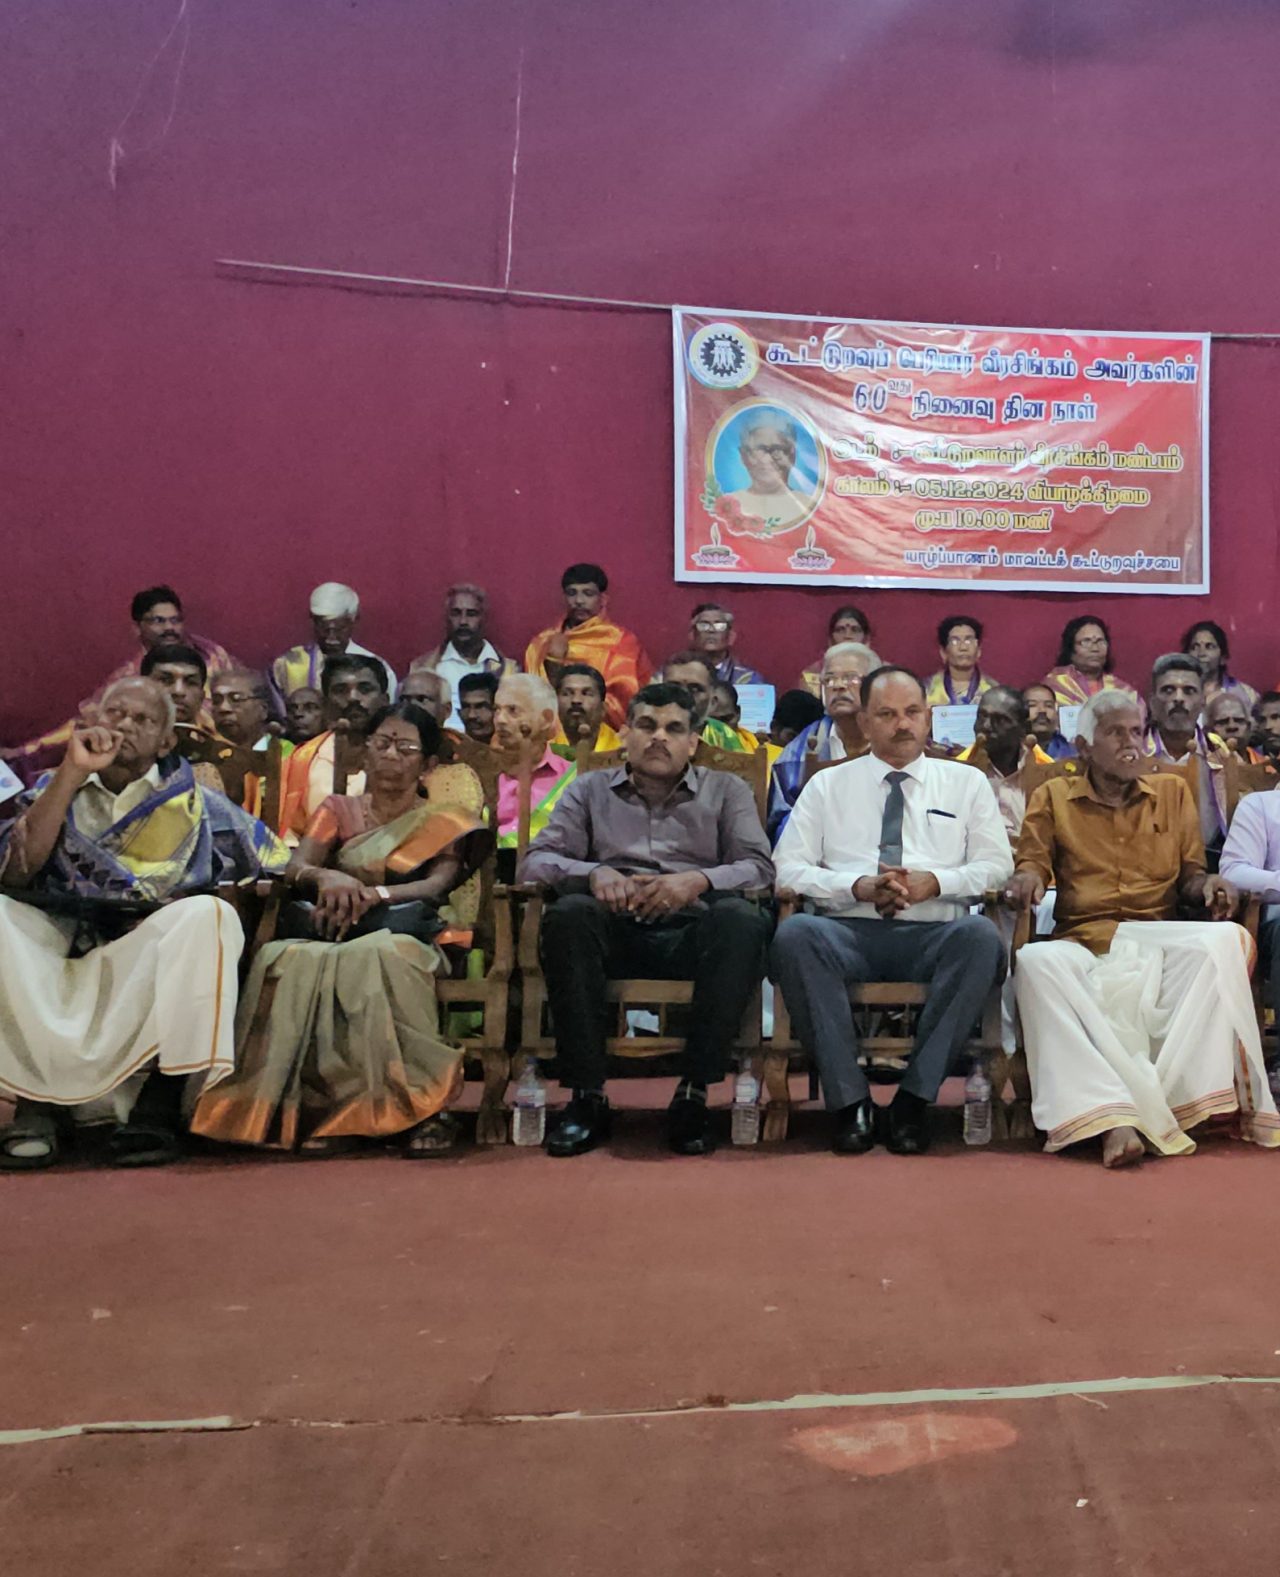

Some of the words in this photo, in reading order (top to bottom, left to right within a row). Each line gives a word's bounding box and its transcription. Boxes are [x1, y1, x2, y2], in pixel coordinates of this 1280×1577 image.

[982, 349, 1077, 379] வீரசிங்கம்
[1085, 354, 1197, 385] அவர்களின்
[912, 391, 994, 419] நினைவு
[1004, 395, 1044, 421] தின
[1052, 395, 1096, 422] நாள்
[1113, 446, 1182, 470] மண்டபம்
[915, 479, 1024, 499] 05.12.2024
[1028, 479, 1149, 511] வியாழக்கிழமை
[956, 510, 1010, 529] 10.00
[1013, 510, 1052, 531] மணி
[905, 546, 997, 568] யாழ்ப்பாணம்
[1004, 549, 1066, 567] மாவட்டக்
